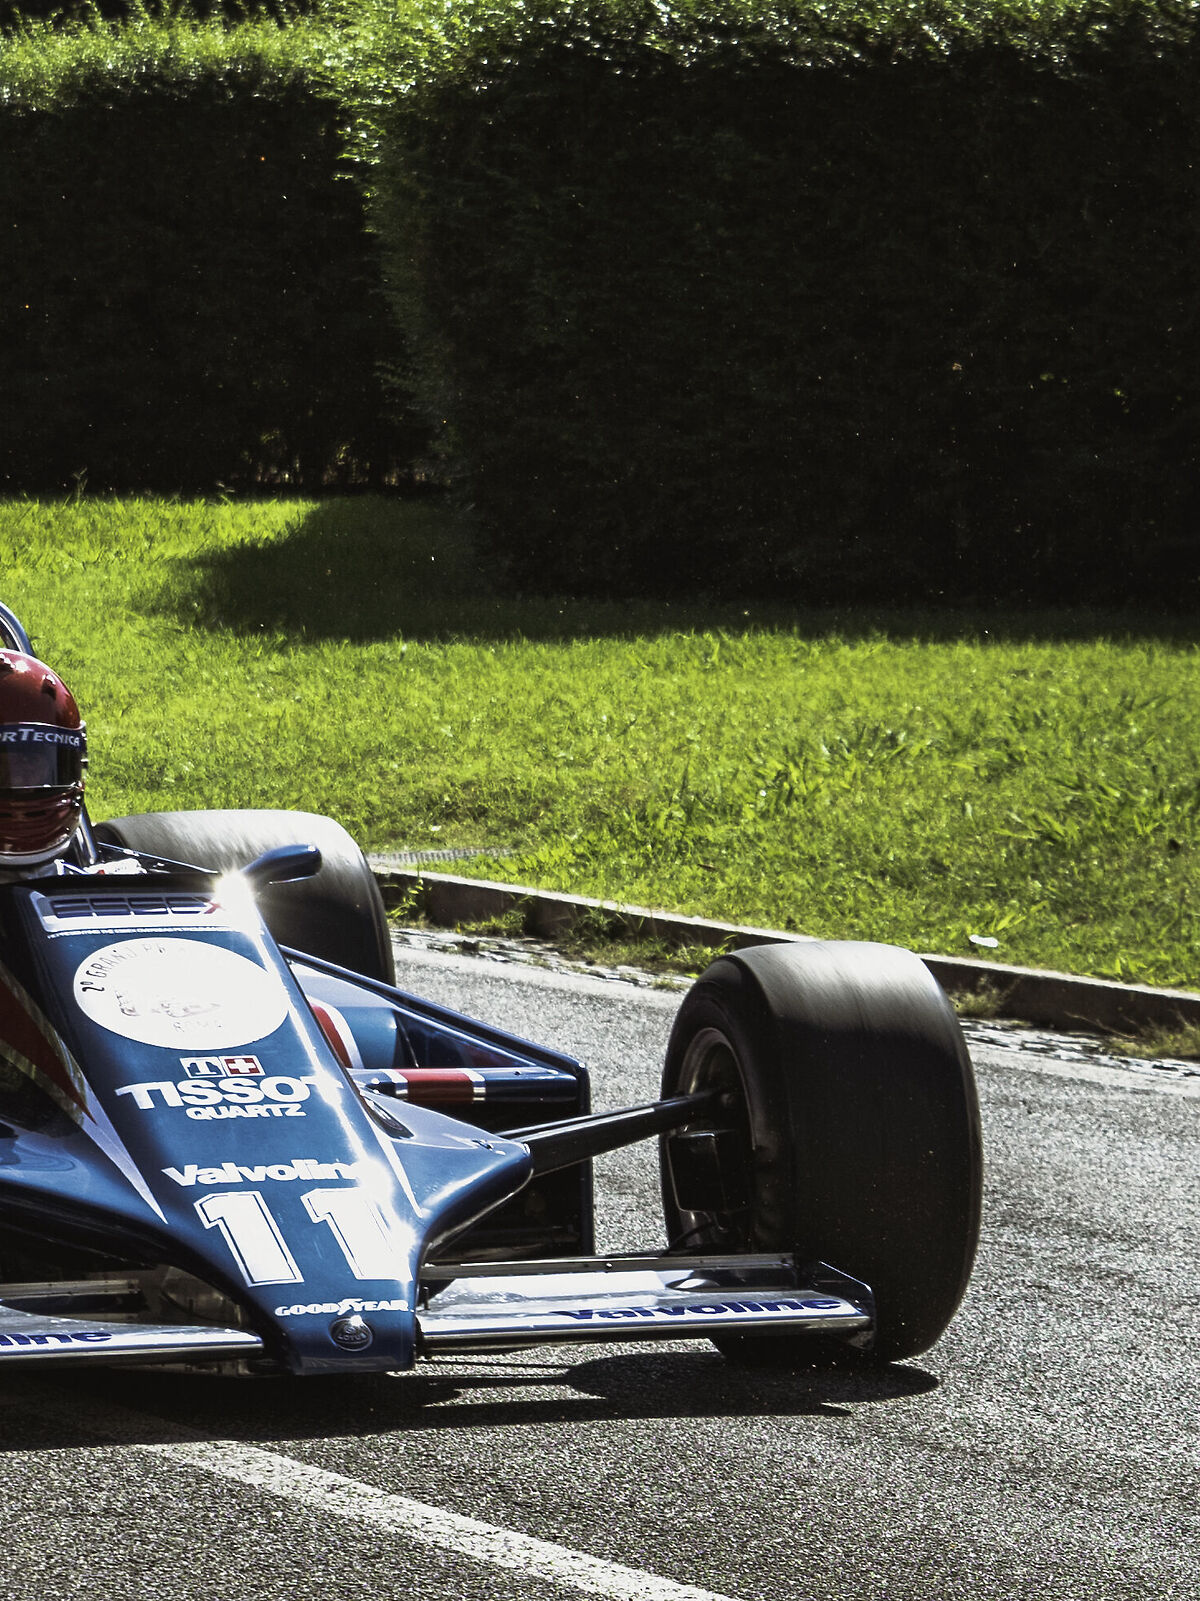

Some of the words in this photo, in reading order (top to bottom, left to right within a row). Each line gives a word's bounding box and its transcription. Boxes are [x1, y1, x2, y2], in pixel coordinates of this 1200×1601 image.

[116, 1076, 343, 1110] TISSOT
[186, 1103, 307, 1120] QUARTZ
[193, 1187, 413, 1287] 11
[552, 1297, 842, 1320] Valvoline
